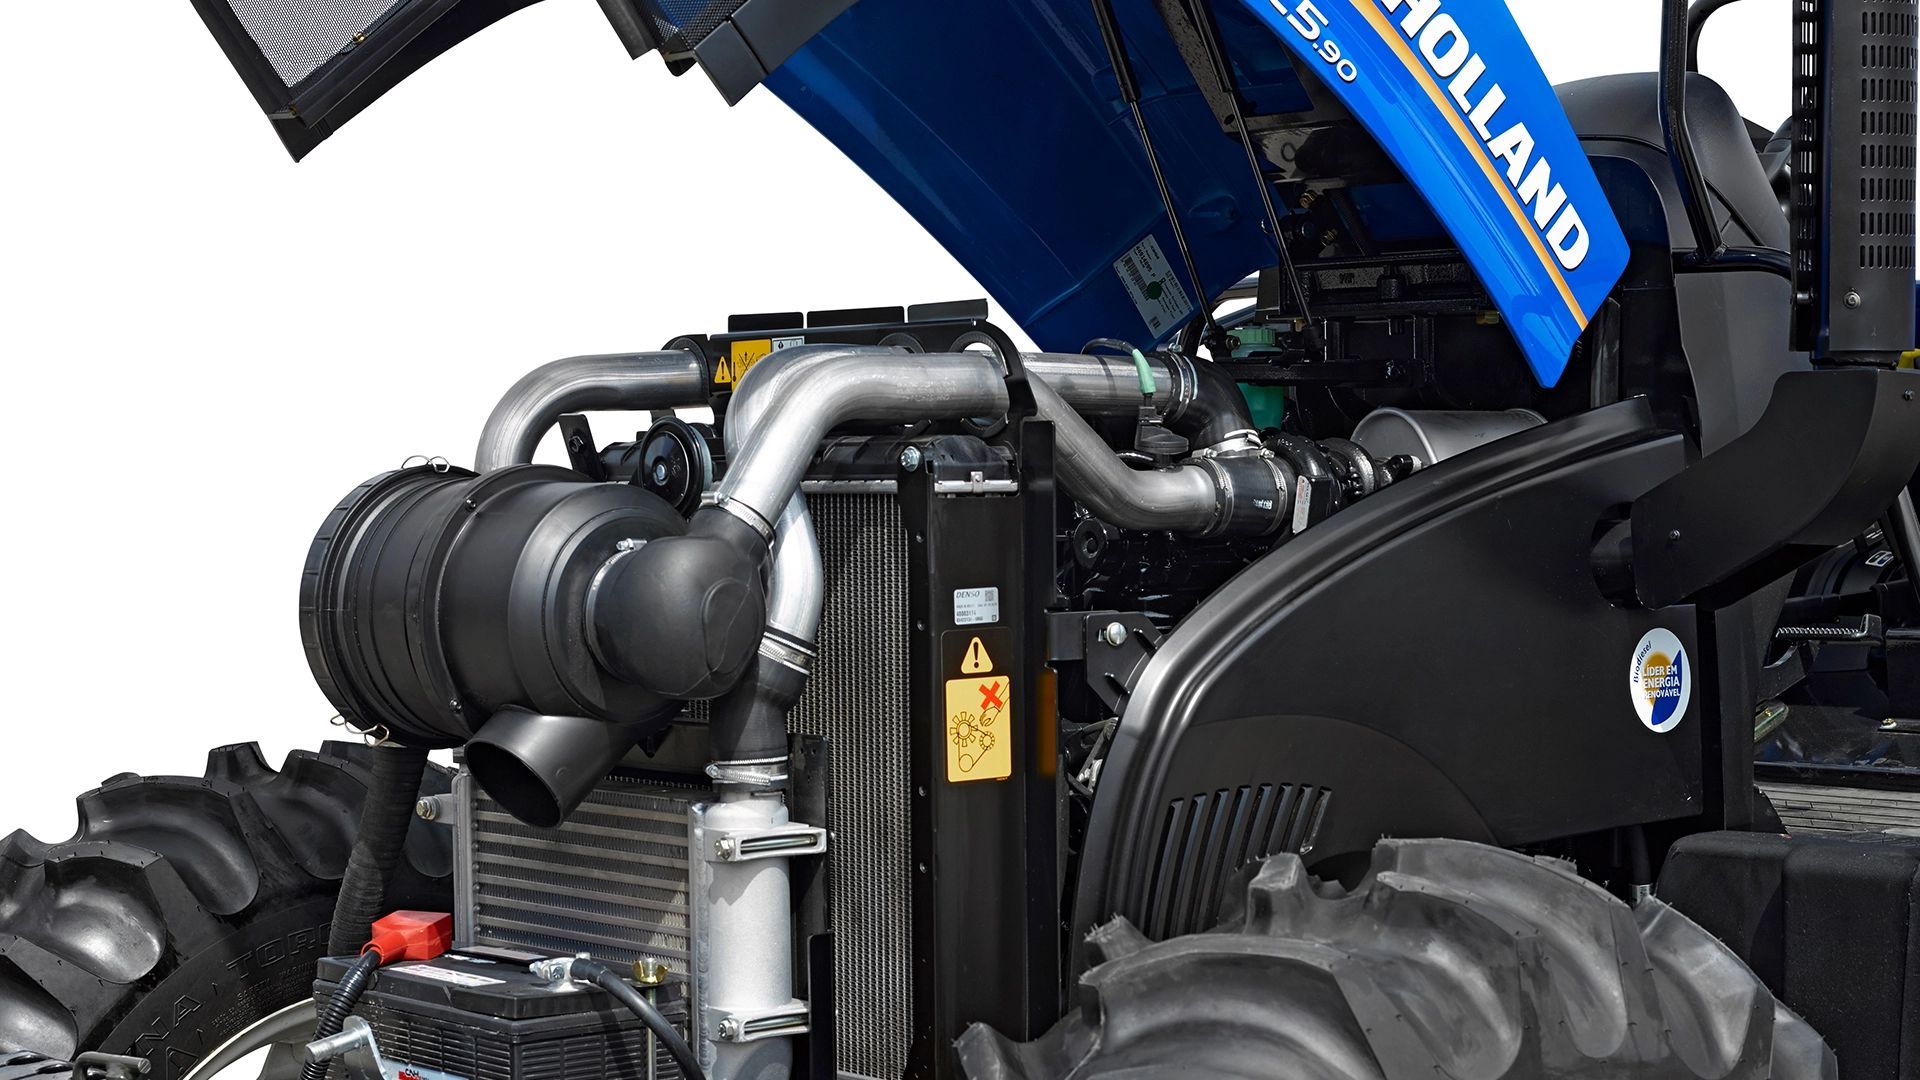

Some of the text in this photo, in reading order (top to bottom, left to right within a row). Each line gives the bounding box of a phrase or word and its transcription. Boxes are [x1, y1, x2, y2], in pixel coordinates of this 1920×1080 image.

[1633, 641, 1653, 683] Biodiesel
[1643, 664, 1678, 677] LÍDER EM
[1643, 676, 1680, 689] ENERGIA
